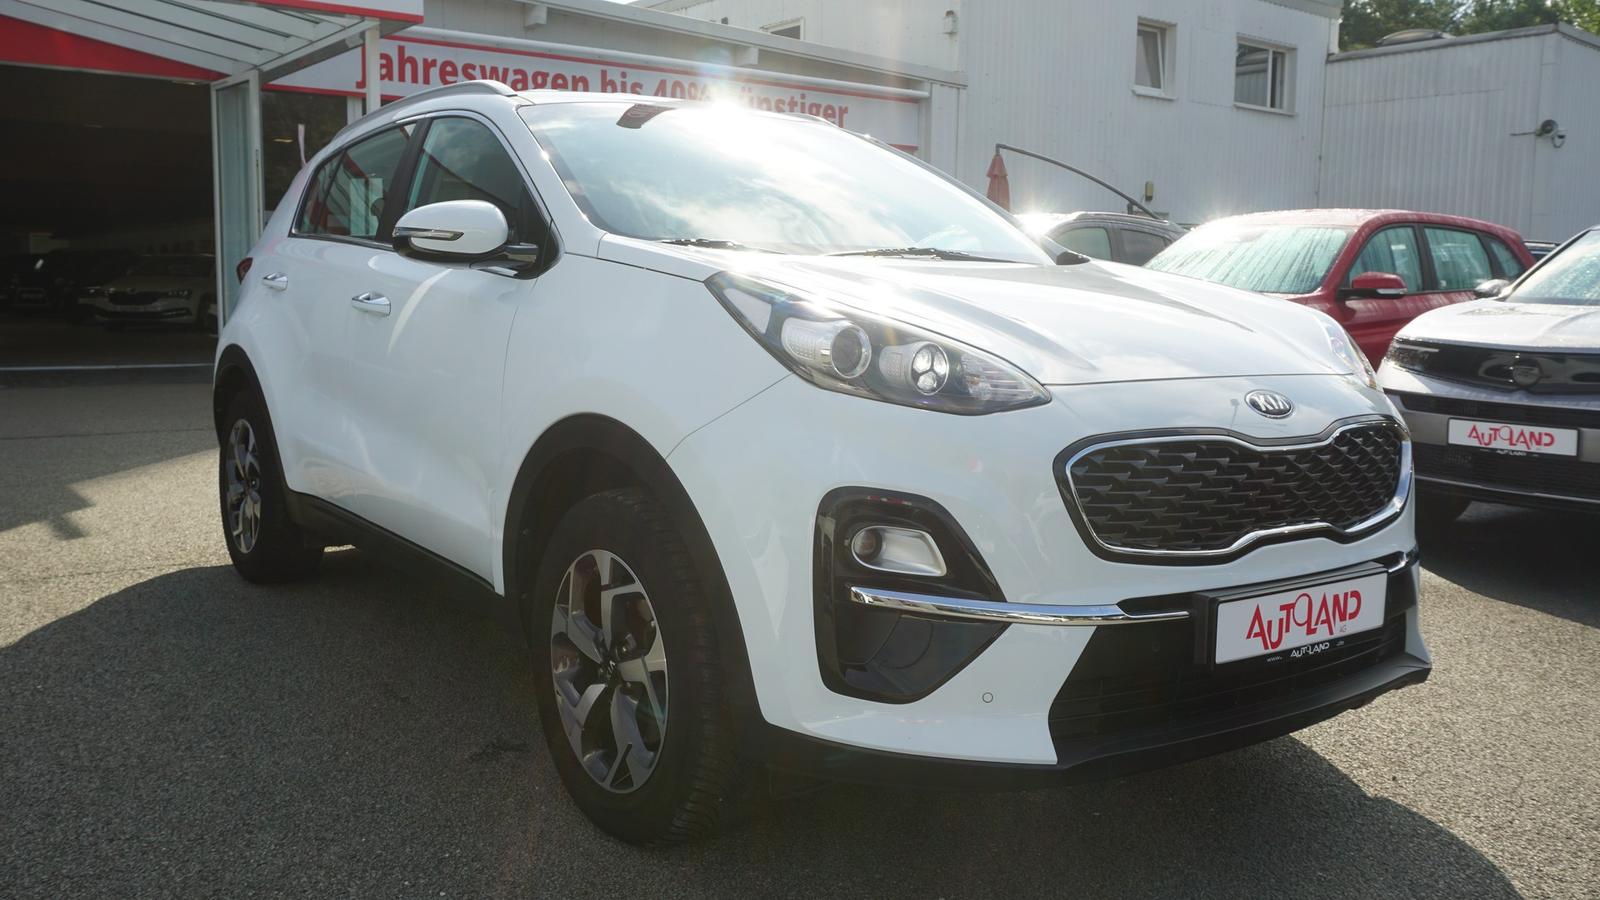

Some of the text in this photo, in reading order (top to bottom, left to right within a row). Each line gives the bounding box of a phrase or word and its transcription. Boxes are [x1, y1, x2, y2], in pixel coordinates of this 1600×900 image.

[600, 69, 643, 95] bis
[738, 85, 848, 128] ünstiger
[1467, 424, 1555, 450] AUTOLAND
[1246, 590, 1362, 650] AUTOLAND
[1290, 642, 1329, 657] AUTOLAND
